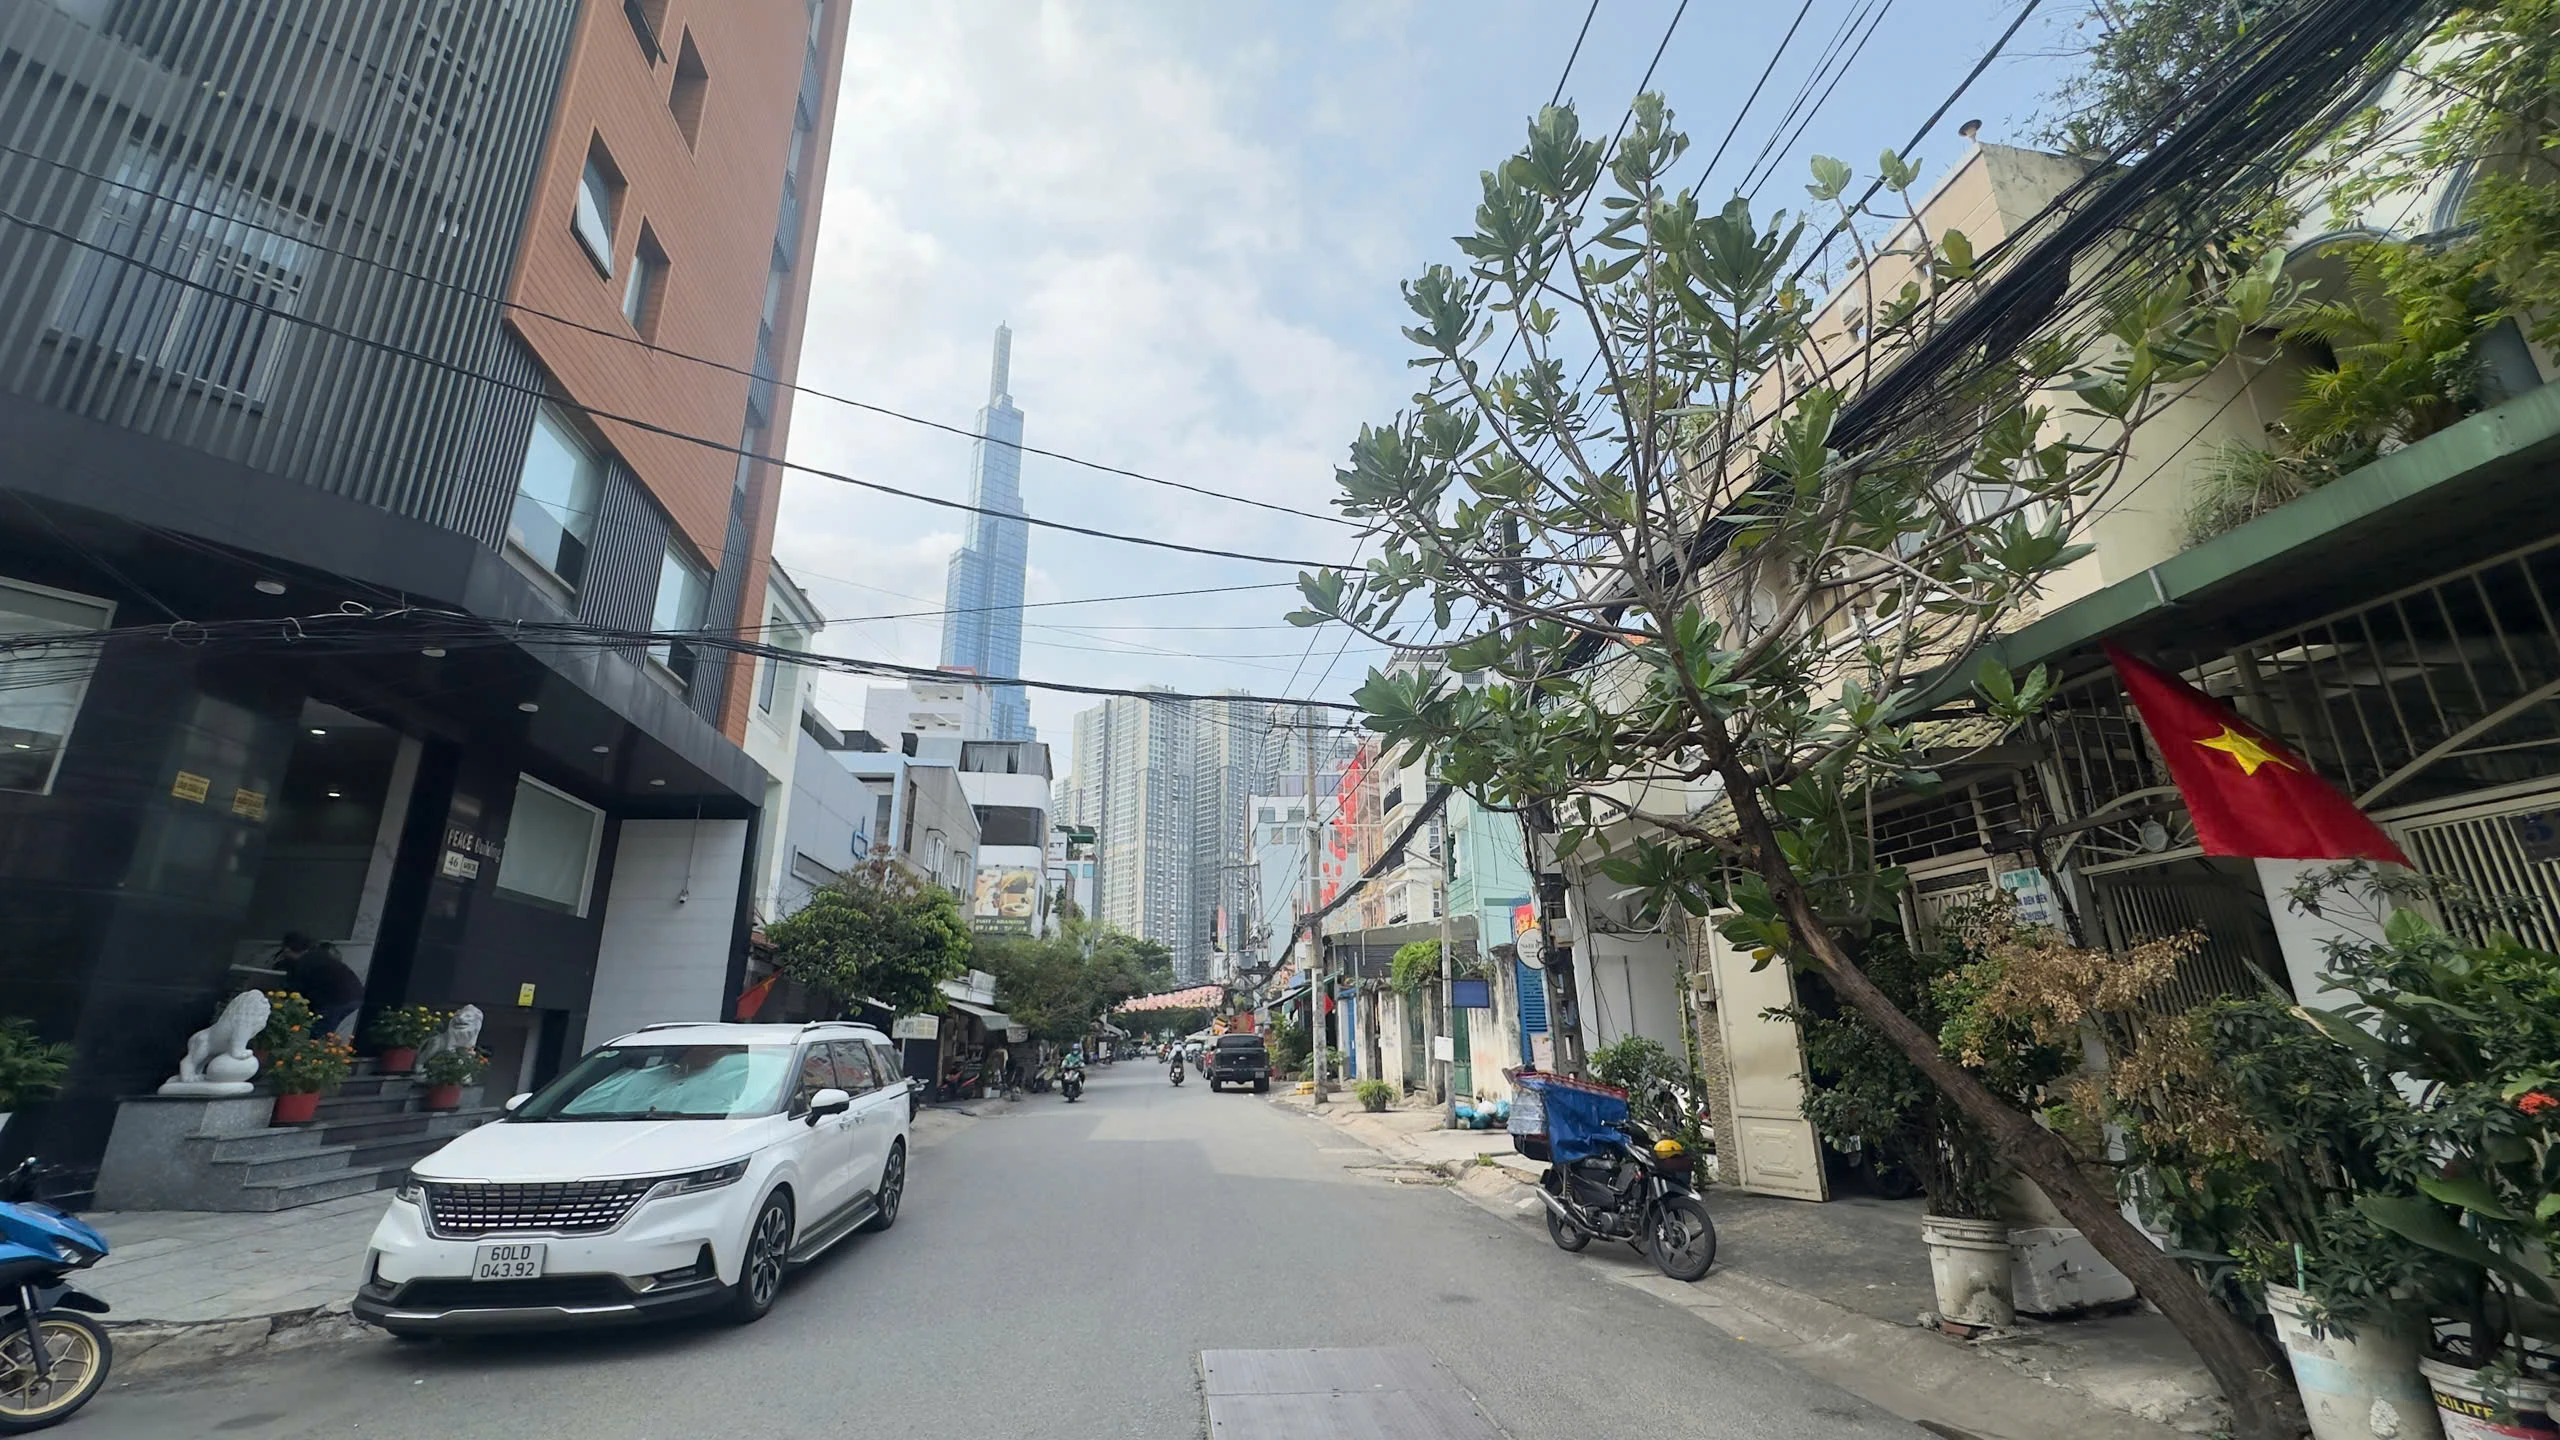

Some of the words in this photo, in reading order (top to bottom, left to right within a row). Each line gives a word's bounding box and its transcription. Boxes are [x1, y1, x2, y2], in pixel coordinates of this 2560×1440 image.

[447, 829, 474, 851] PEACE
[491, 1245, 531, 1261] 60LD
[480, 1262, 535, 1278] 043.92
